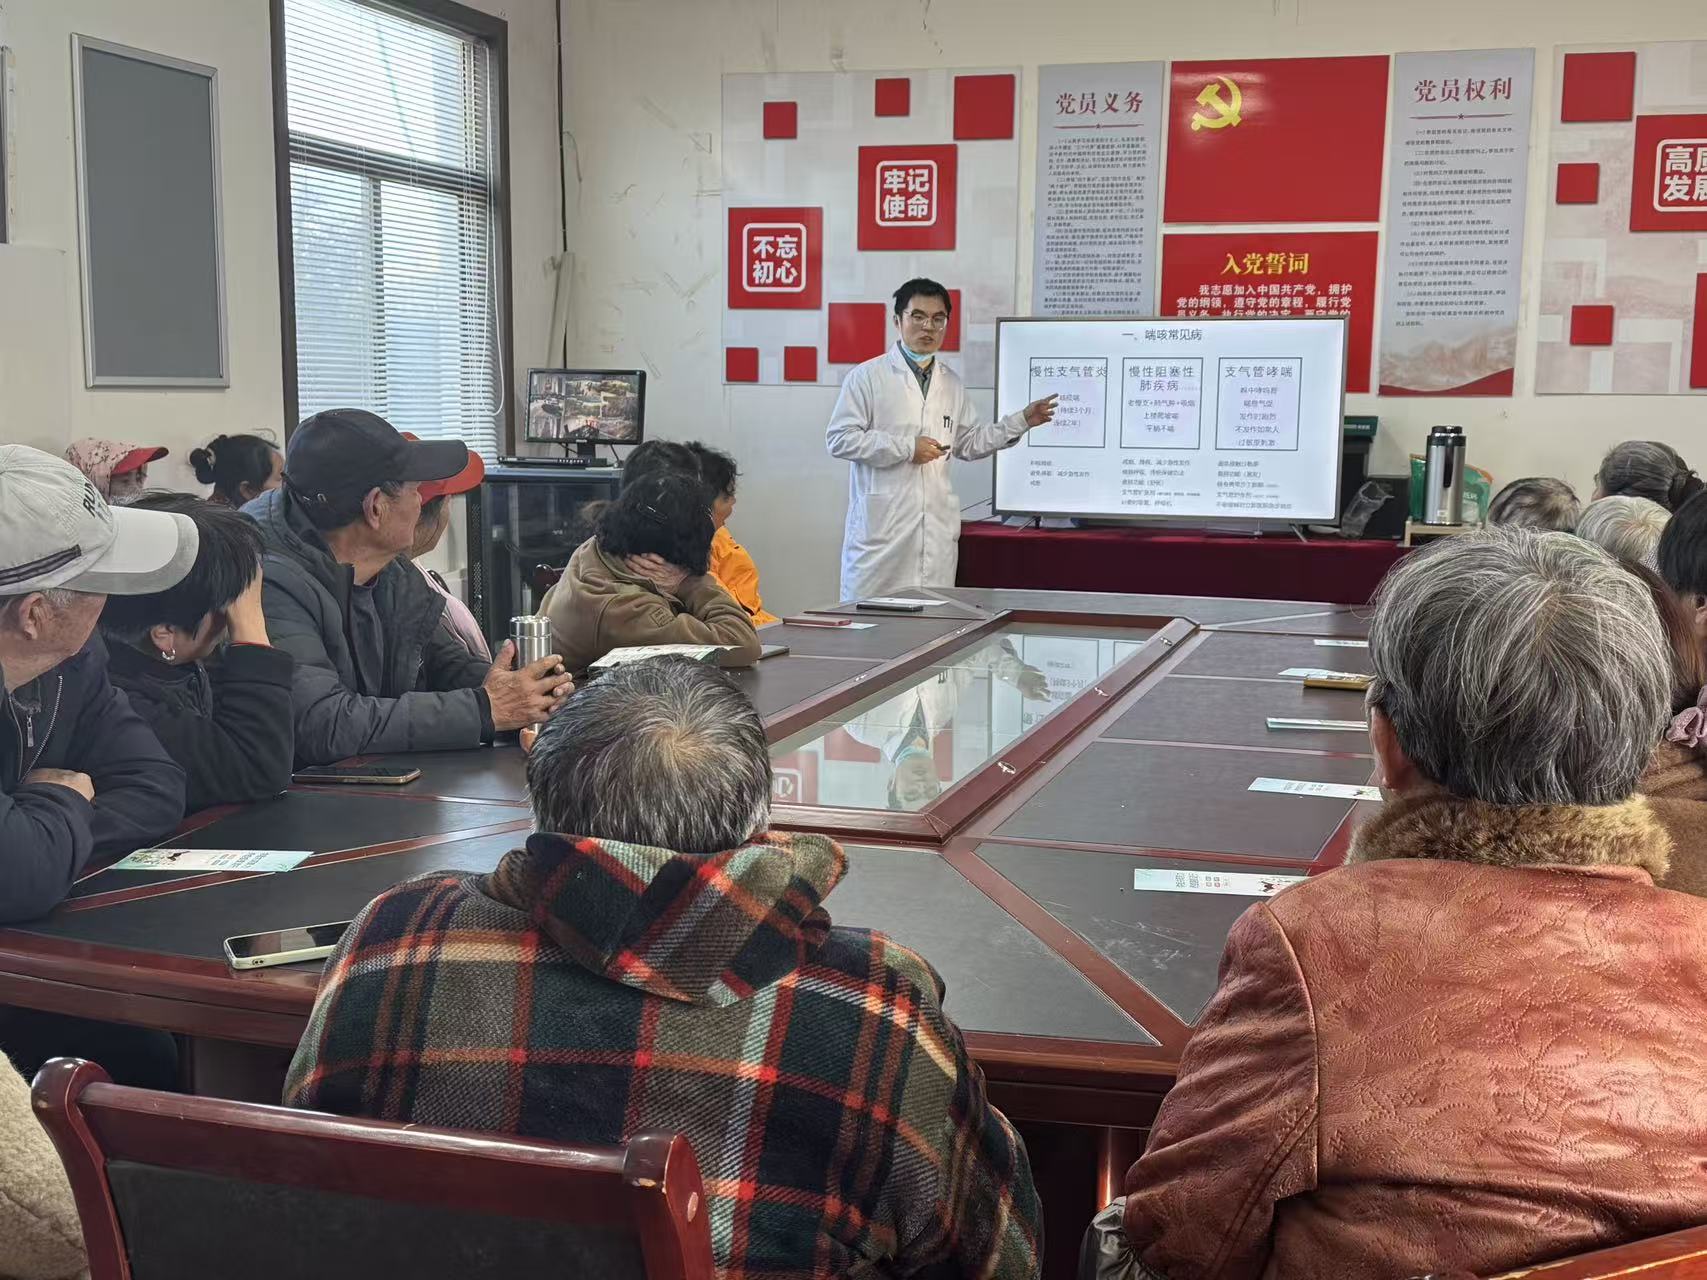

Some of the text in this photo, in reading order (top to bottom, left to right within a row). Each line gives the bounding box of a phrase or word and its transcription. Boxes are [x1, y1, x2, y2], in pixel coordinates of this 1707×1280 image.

[1412, 77, 1512, 103] 党员权利
[1056, 91, 1143, 115] 党员义务
[883, 168, 930, 193] 牢记
[883, 194, 930, 218] 使命
[753, 235, 798, 259] 不忘
[753, 260, 798, 284] 初心
[1220, 253, 1309, 275] 入党誓词
[1199, 284, 1352, 296] 我志愿加入中国共产党，拥护
[1177, 297, 1352, 309] 党的纲领，遵守党的章程，履行党
[1122, 328, 1202, 341] 一、喘咳常见病
[1031, 366, 1108, 378] 慢性支气管炎
[1129, 366, 1195, 378] 慢性阻塞性
[1225, 366, 1293, 378] 支气管哮喘
[1139, 379, 1179, 392] 肺疾病
